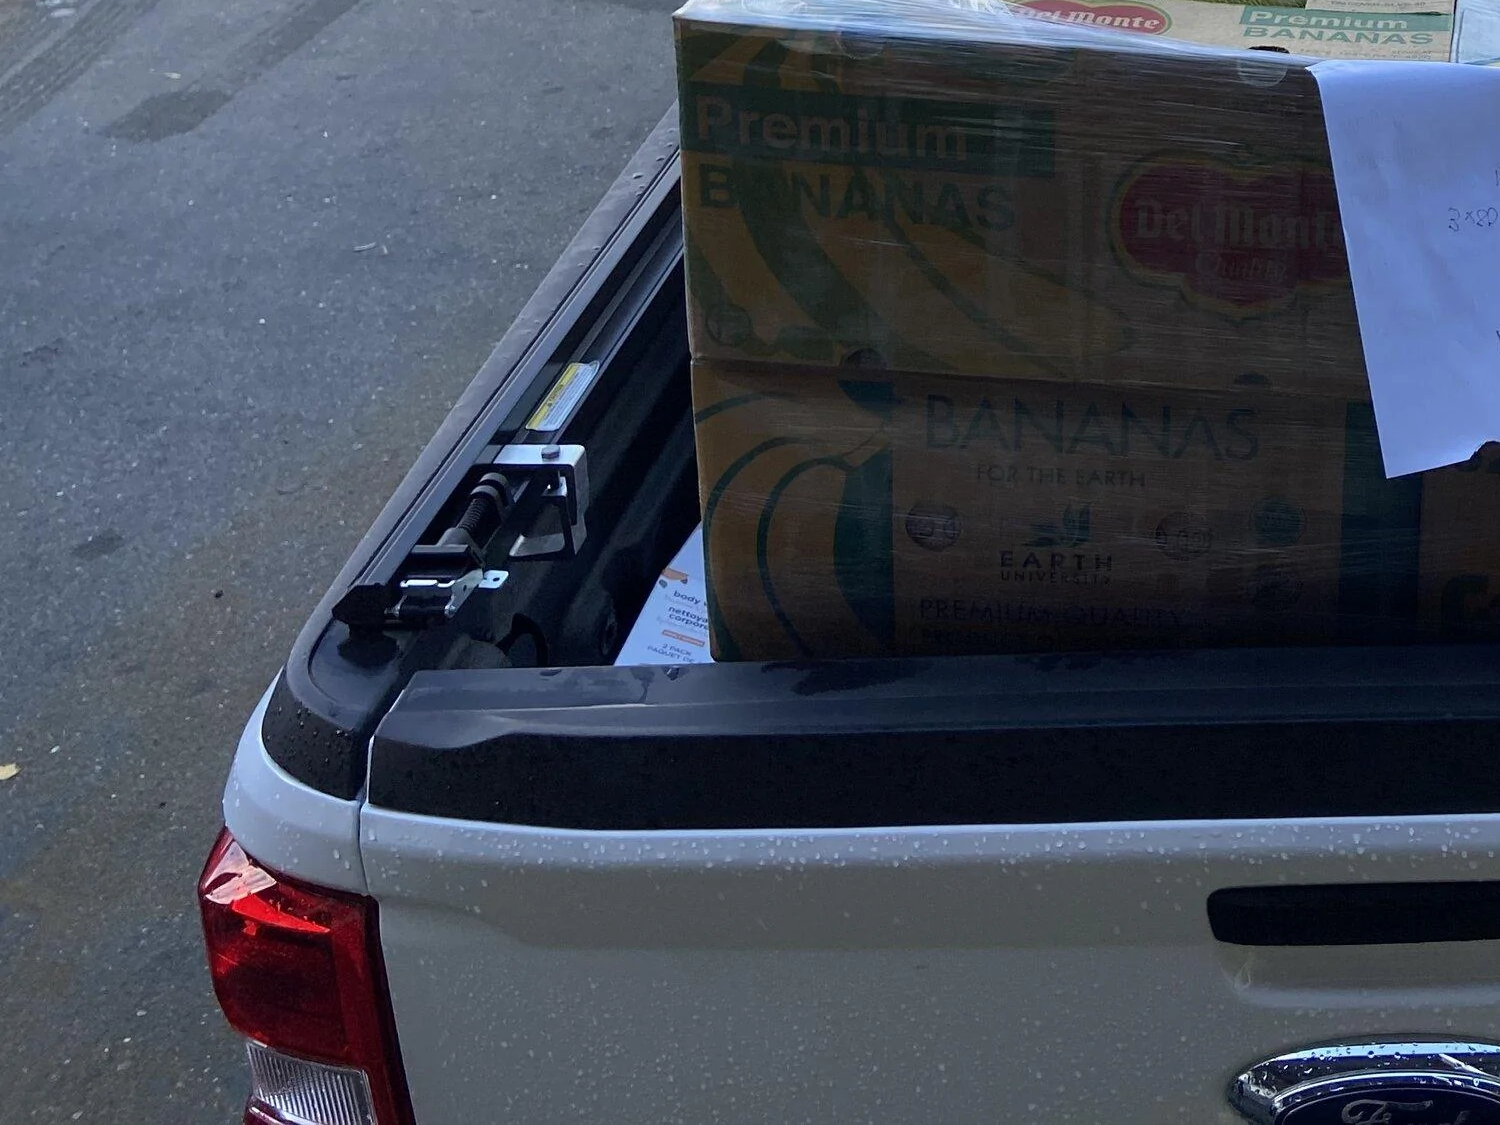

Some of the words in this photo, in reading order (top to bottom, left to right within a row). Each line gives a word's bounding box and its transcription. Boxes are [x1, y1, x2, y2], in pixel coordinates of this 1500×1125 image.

[1066, 11, 1162, 31] Monte
[1248, 12, 1409, 31] Premium
[1243, 26, 1435, 46] BANANAS
[696, 95, 968, 162] Premium
[698, 163, 1017, 232] BNANAS
[1134, 200, 1203, 245] Del
[926, 393, 1262, 461] BANANAS
[975, 463, 1020, 484] FOR
[1027, 466, 1067, 485] THE
[1075, 468, 1147, 488] EARTH
[998, 551, 1114, 573] EARTH
[673, 589, 701, 605] body
[919, 597, 1055, 623] PREMIUM
